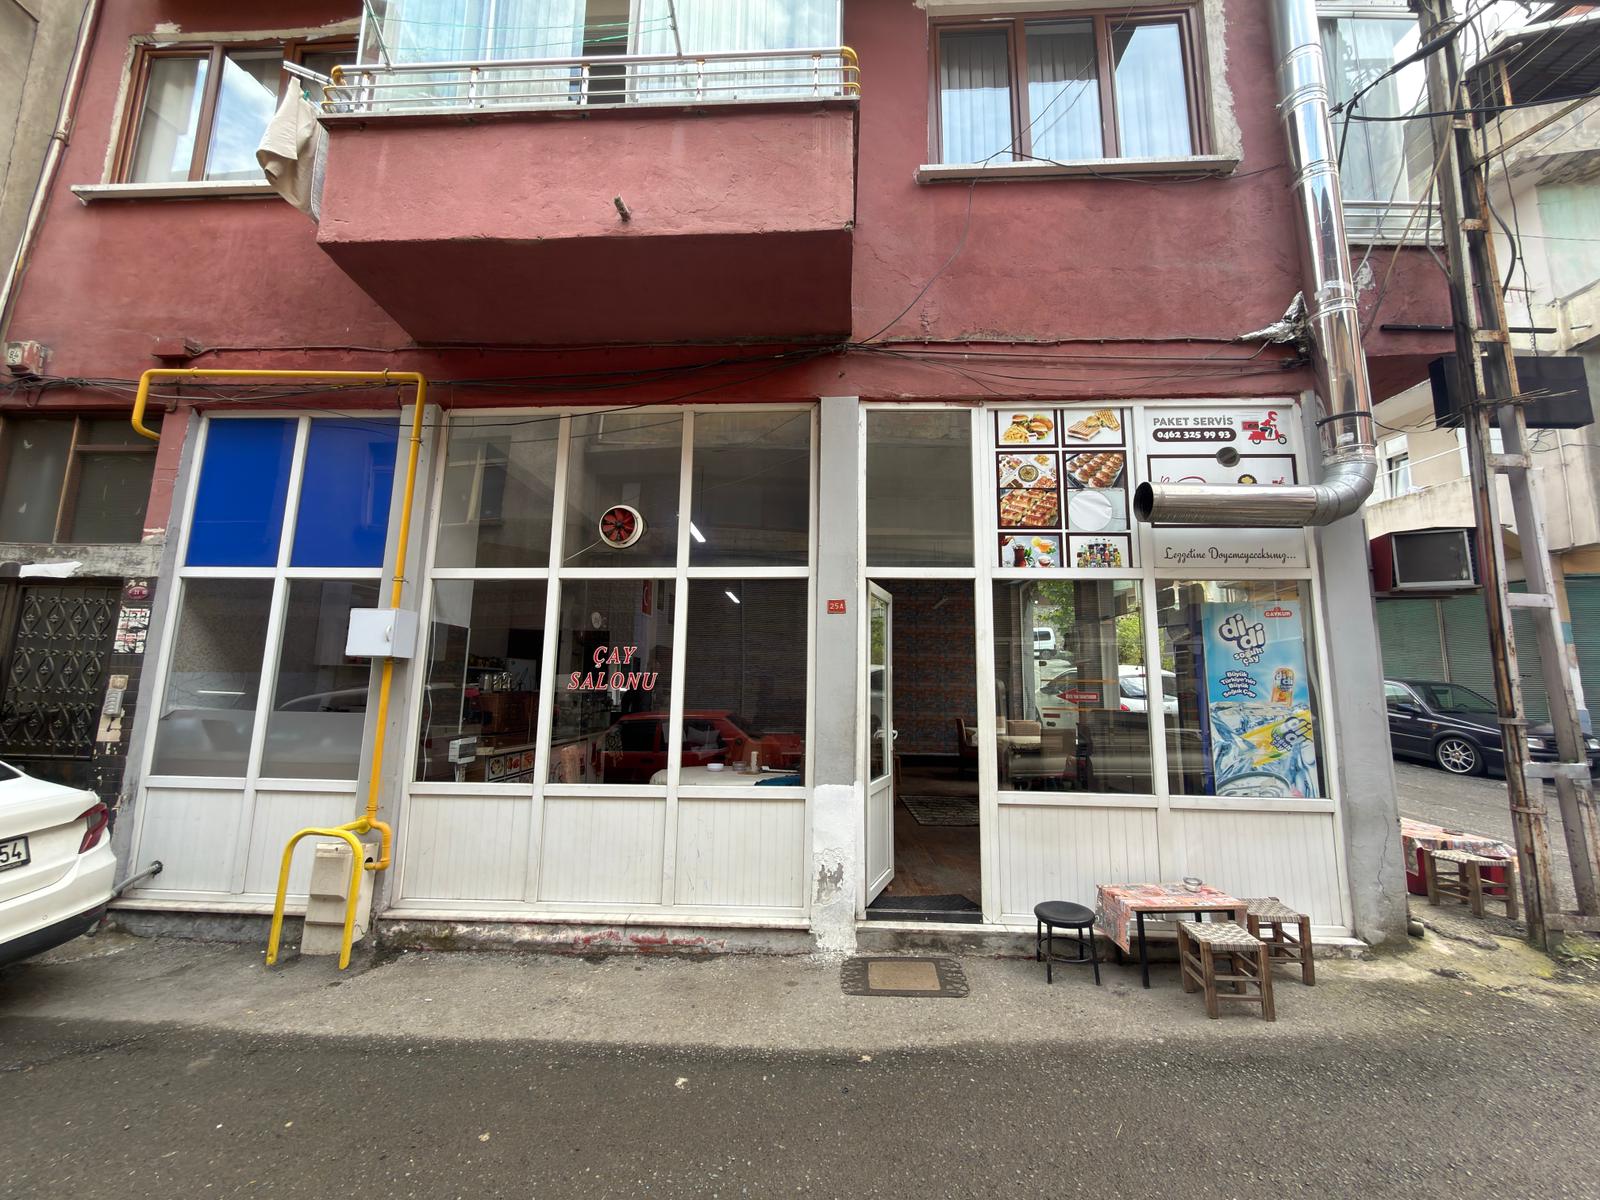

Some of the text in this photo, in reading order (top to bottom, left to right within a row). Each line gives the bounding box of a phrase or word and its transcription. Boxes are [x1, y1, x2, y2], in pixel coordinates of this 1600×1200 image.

[1153, 415, 1234, 426] PAKET SERVİS
[1157, 431, 1231, 440] 0462 325 99 93
[1163, 546, 1206, 564] Lezzetine
[829, 602, 845, 610] 25A
[593, 645, 638, 668] ÇAY
[1243, 655, 1259, 667] çay
[567, 671, 659, 691] SALONU
